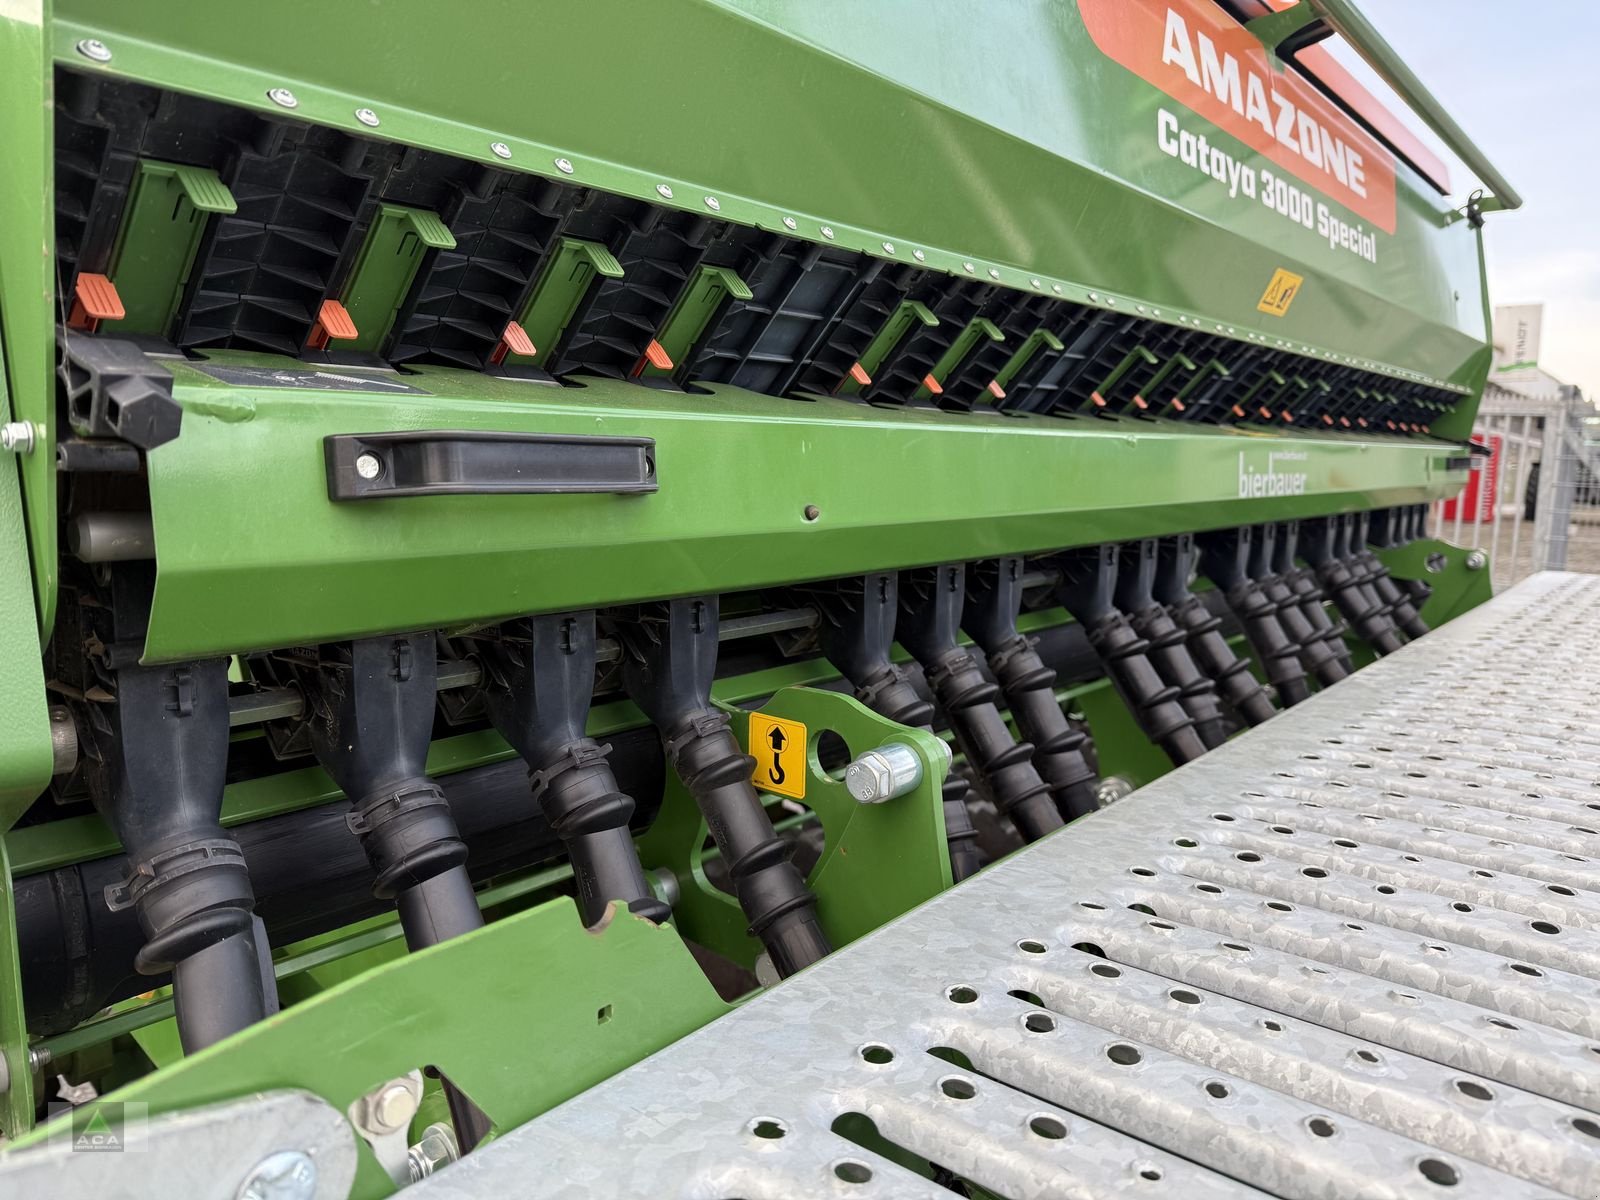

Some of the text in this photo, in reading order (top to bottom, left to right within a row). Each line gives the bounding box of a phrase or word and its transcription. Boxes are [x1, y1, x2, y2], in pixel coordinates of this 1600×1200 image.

[1162, 7, 1367, 199] AMAZONE
[1157, 107, 1377, 264] Cataya 3000 Special
[1239, 451, 1307, 499] bierbauer
